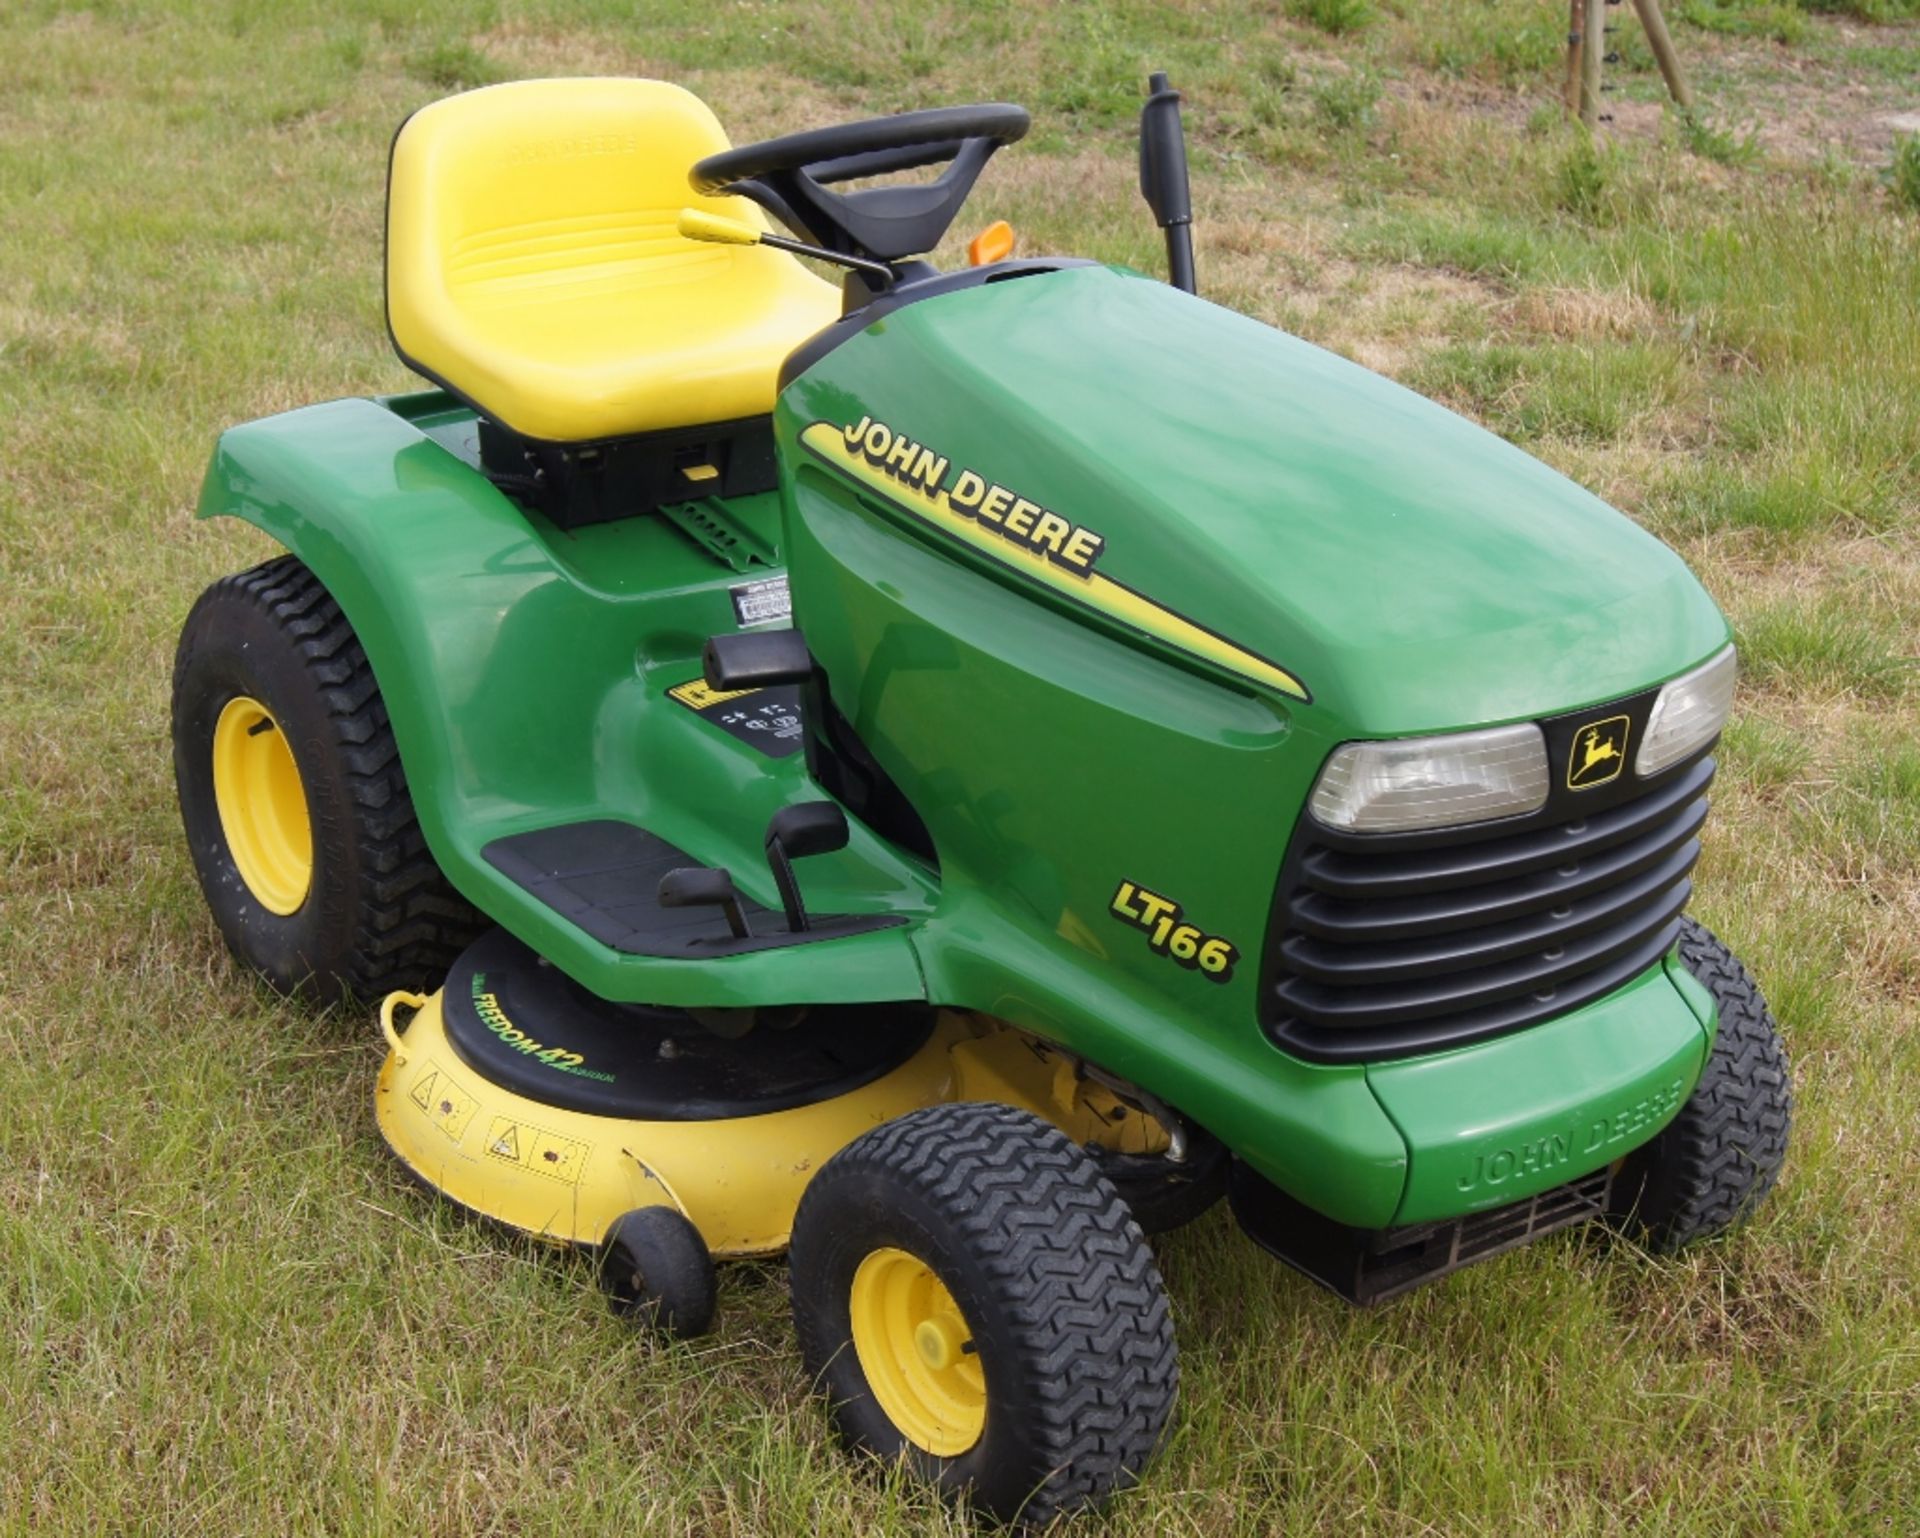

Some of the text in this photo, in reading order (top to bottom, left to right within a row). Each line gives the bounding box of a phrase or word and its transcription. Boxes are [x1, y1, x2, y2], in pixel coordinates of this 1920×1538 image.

[842, 414, 1103, 574] JOHN DEERE
[472, 993, 585, 1073] FREEDOM 42
[1456, 1078, 1682, 1192] JOHN DEERE
